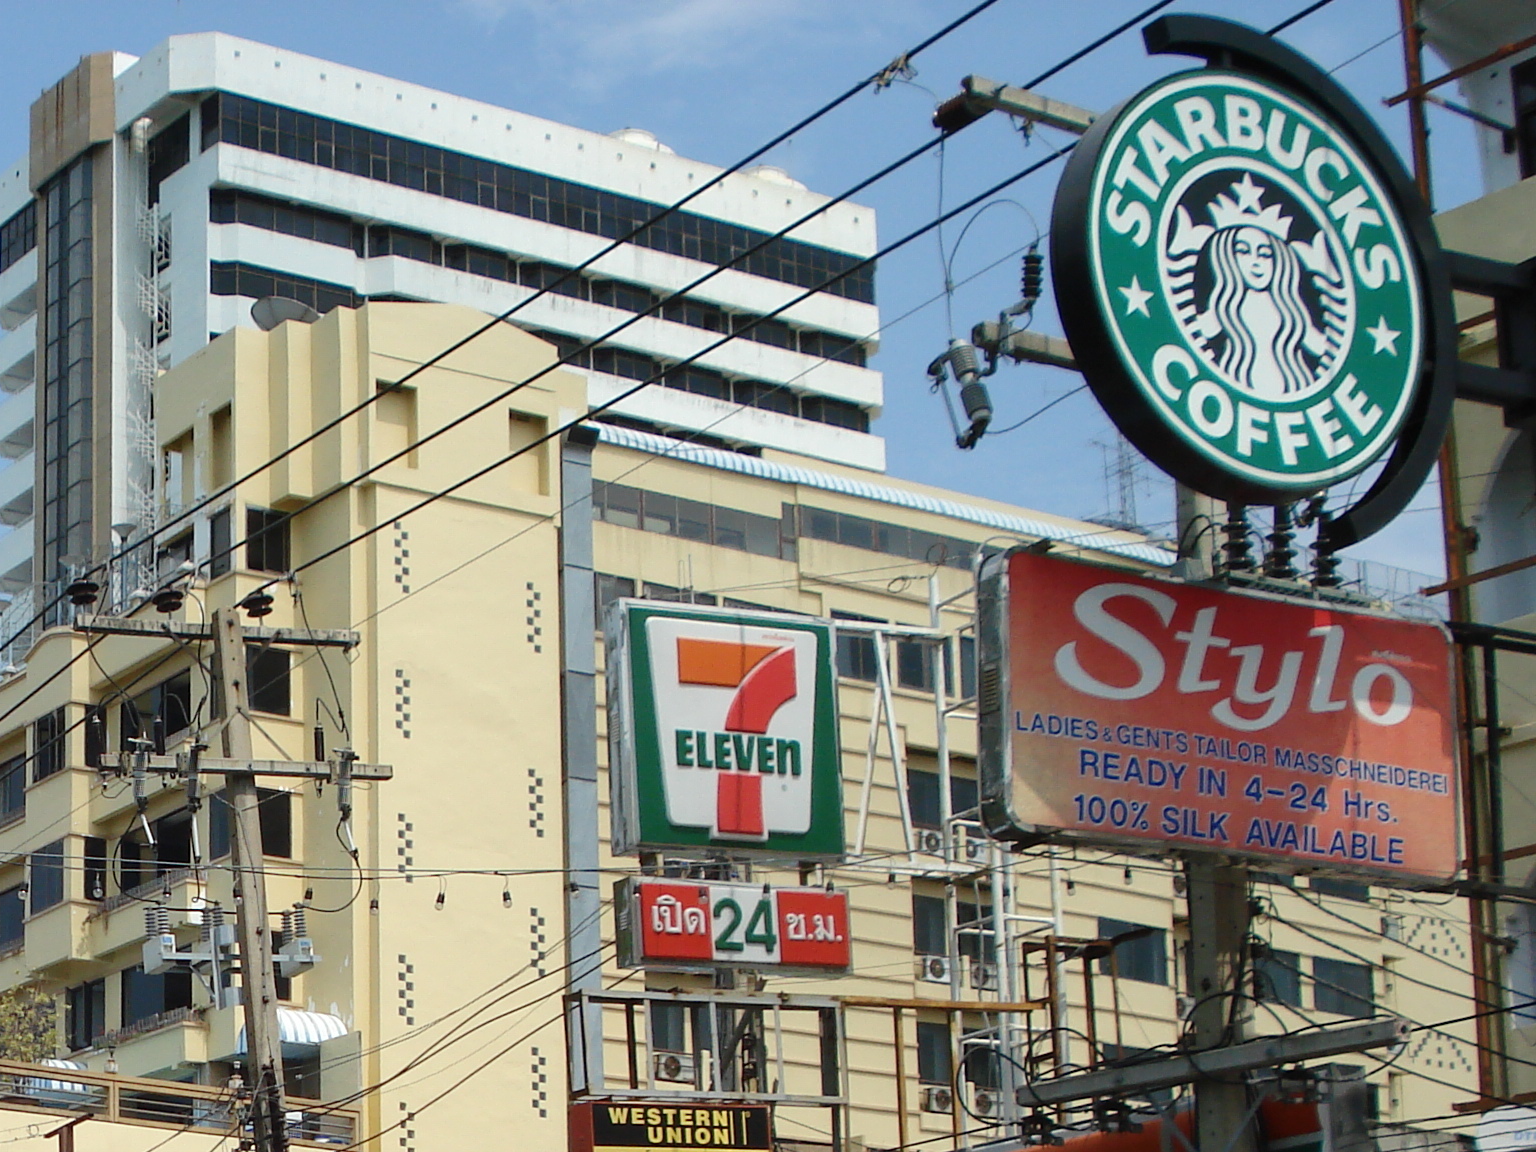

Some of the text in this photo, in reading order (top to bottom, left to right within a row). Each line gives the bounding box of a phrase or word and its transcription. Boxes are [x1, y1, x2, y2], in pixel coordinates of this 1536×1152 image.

[1105, 94, 1400, 291] STARBUCKS
[1151, 344, 1382, 465] COFFEE
[1054, 582, 1413, 732] Stylo
[1015, 709, 1449, 795] LADIES & GENTS TAILOR MASSCHNEIDEREI
[1079, 748, 1186, 796] READY
[1198, 766, 1227, 799] IN
[1344, 789, 1399, 826] Hrs.
[1074, 793, 1405, 867] 100% SILK AVAILABLE
[651, 895, 706, 935] เปิด
[713, 897, 777, 954] 24
[608, 1107, 729, 1127] WESTERN
[647, 1126, 730, 1145] UNION
